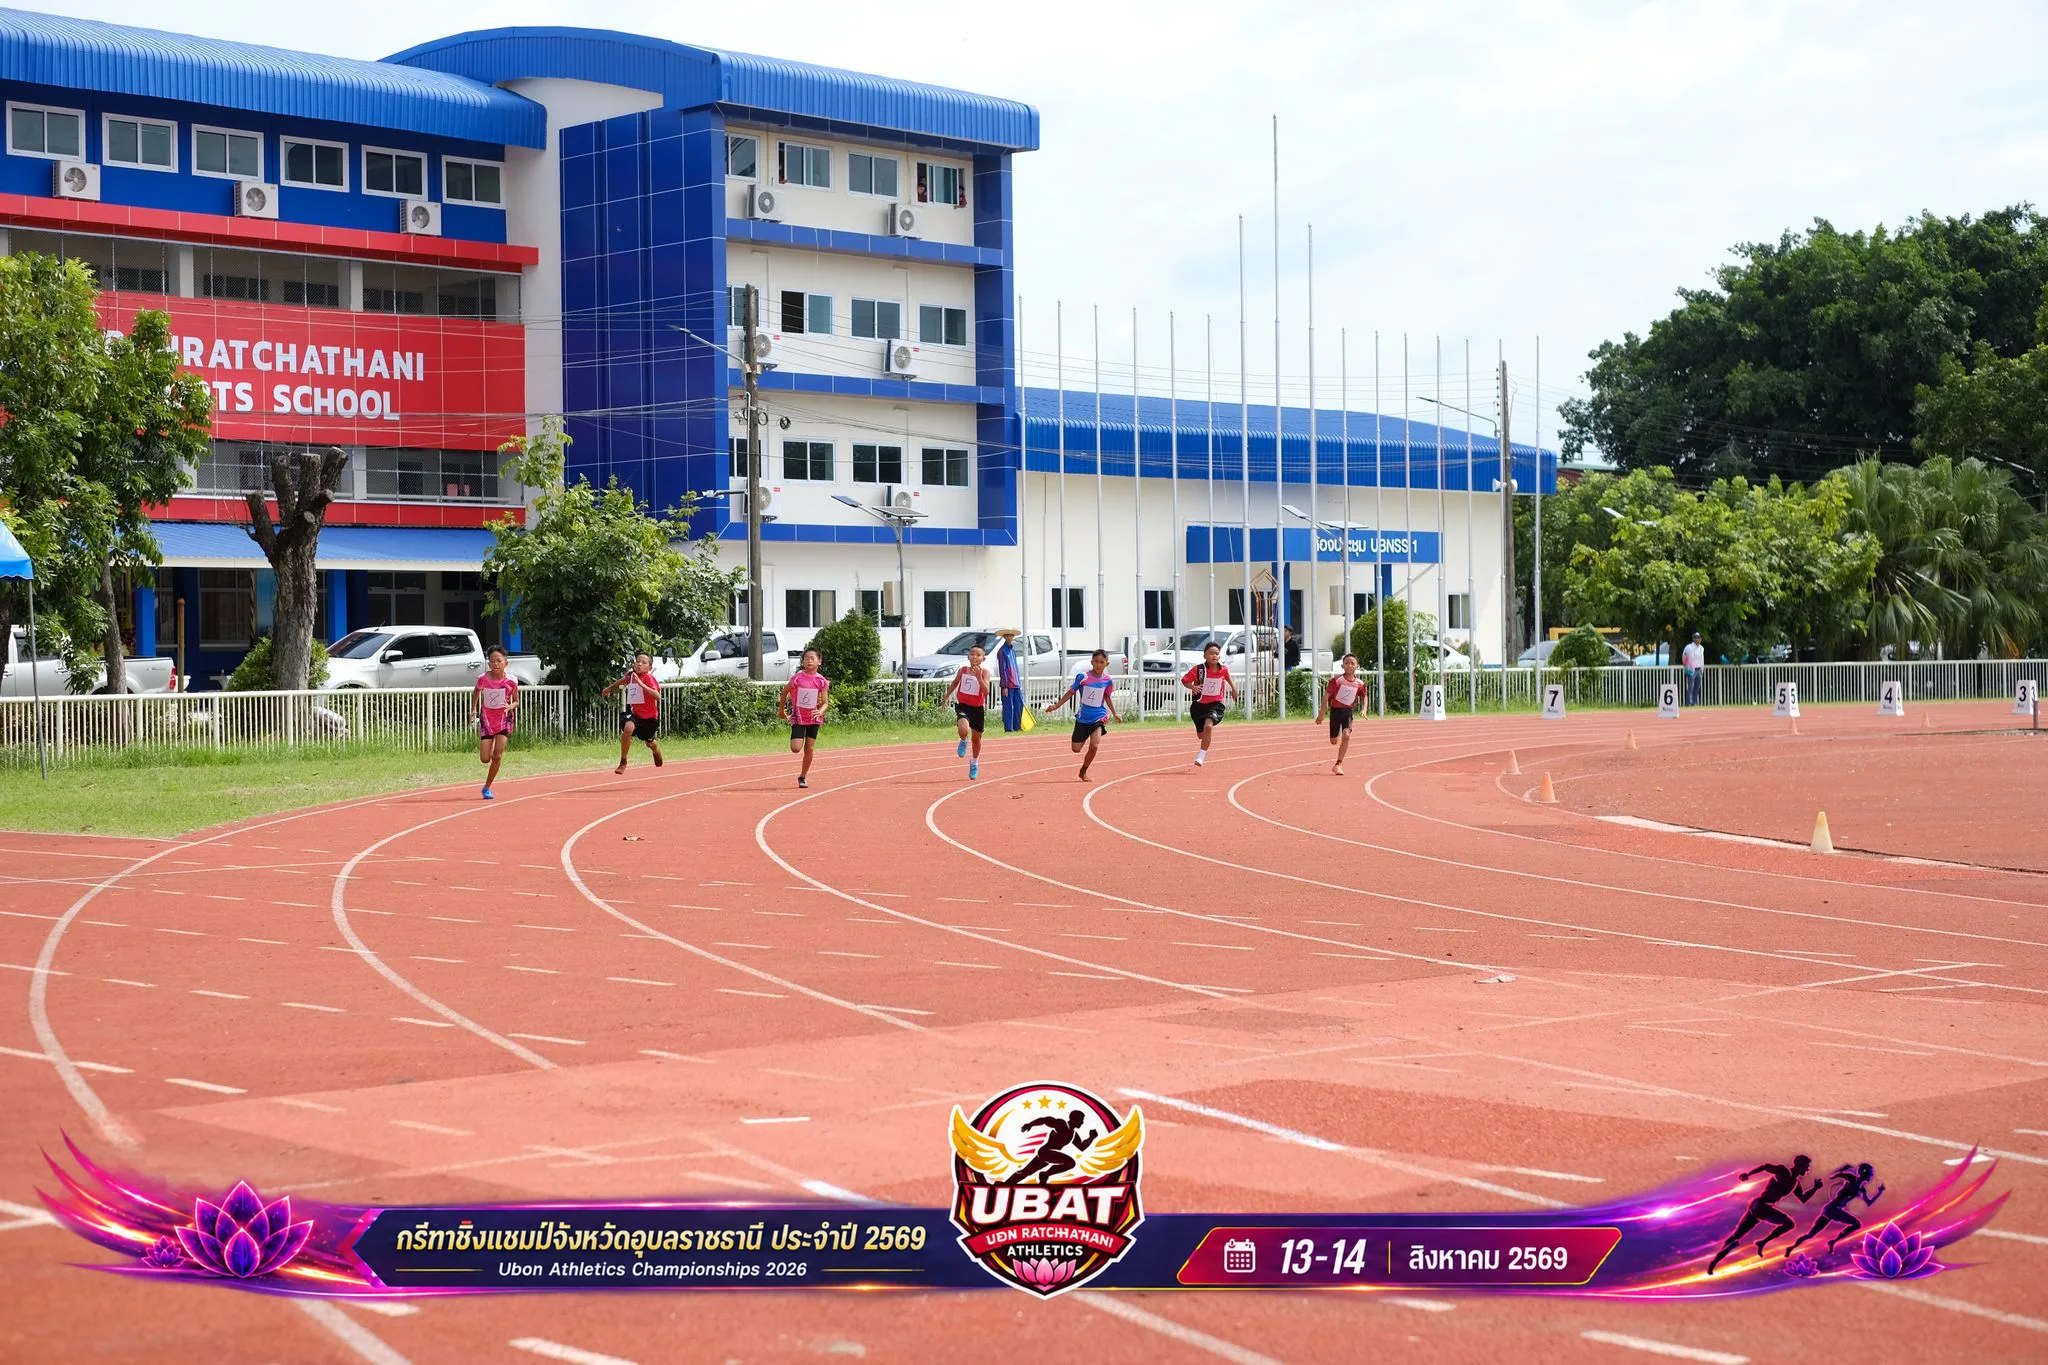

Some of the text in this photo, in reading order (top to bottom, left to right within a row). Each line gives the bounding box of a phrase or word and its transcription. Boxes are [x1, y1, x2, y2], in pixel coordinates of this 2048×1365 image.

[273, 384, 399, 420] SCHOOL
[964, 678, 974, 691] 5
[1208, 681, 1217, 694] 3
[489, 691, 500, 708] 8
[1087, 690, 1096, 703] 4
[1341, 689, 1352, 701] 2
[1424, 690, 1432, 708] 8
[1435, 690, 1442, 708] 8
[1548, 690, 1560, 708] 7
[1663, 688, 1674, 706] 6
[1778, 687, 1787, 704] 5
[1790, 688, 1796, 705] 5
[1884, 687, 1893, 704] 4
[2018, 686, 2027, 702] 3
